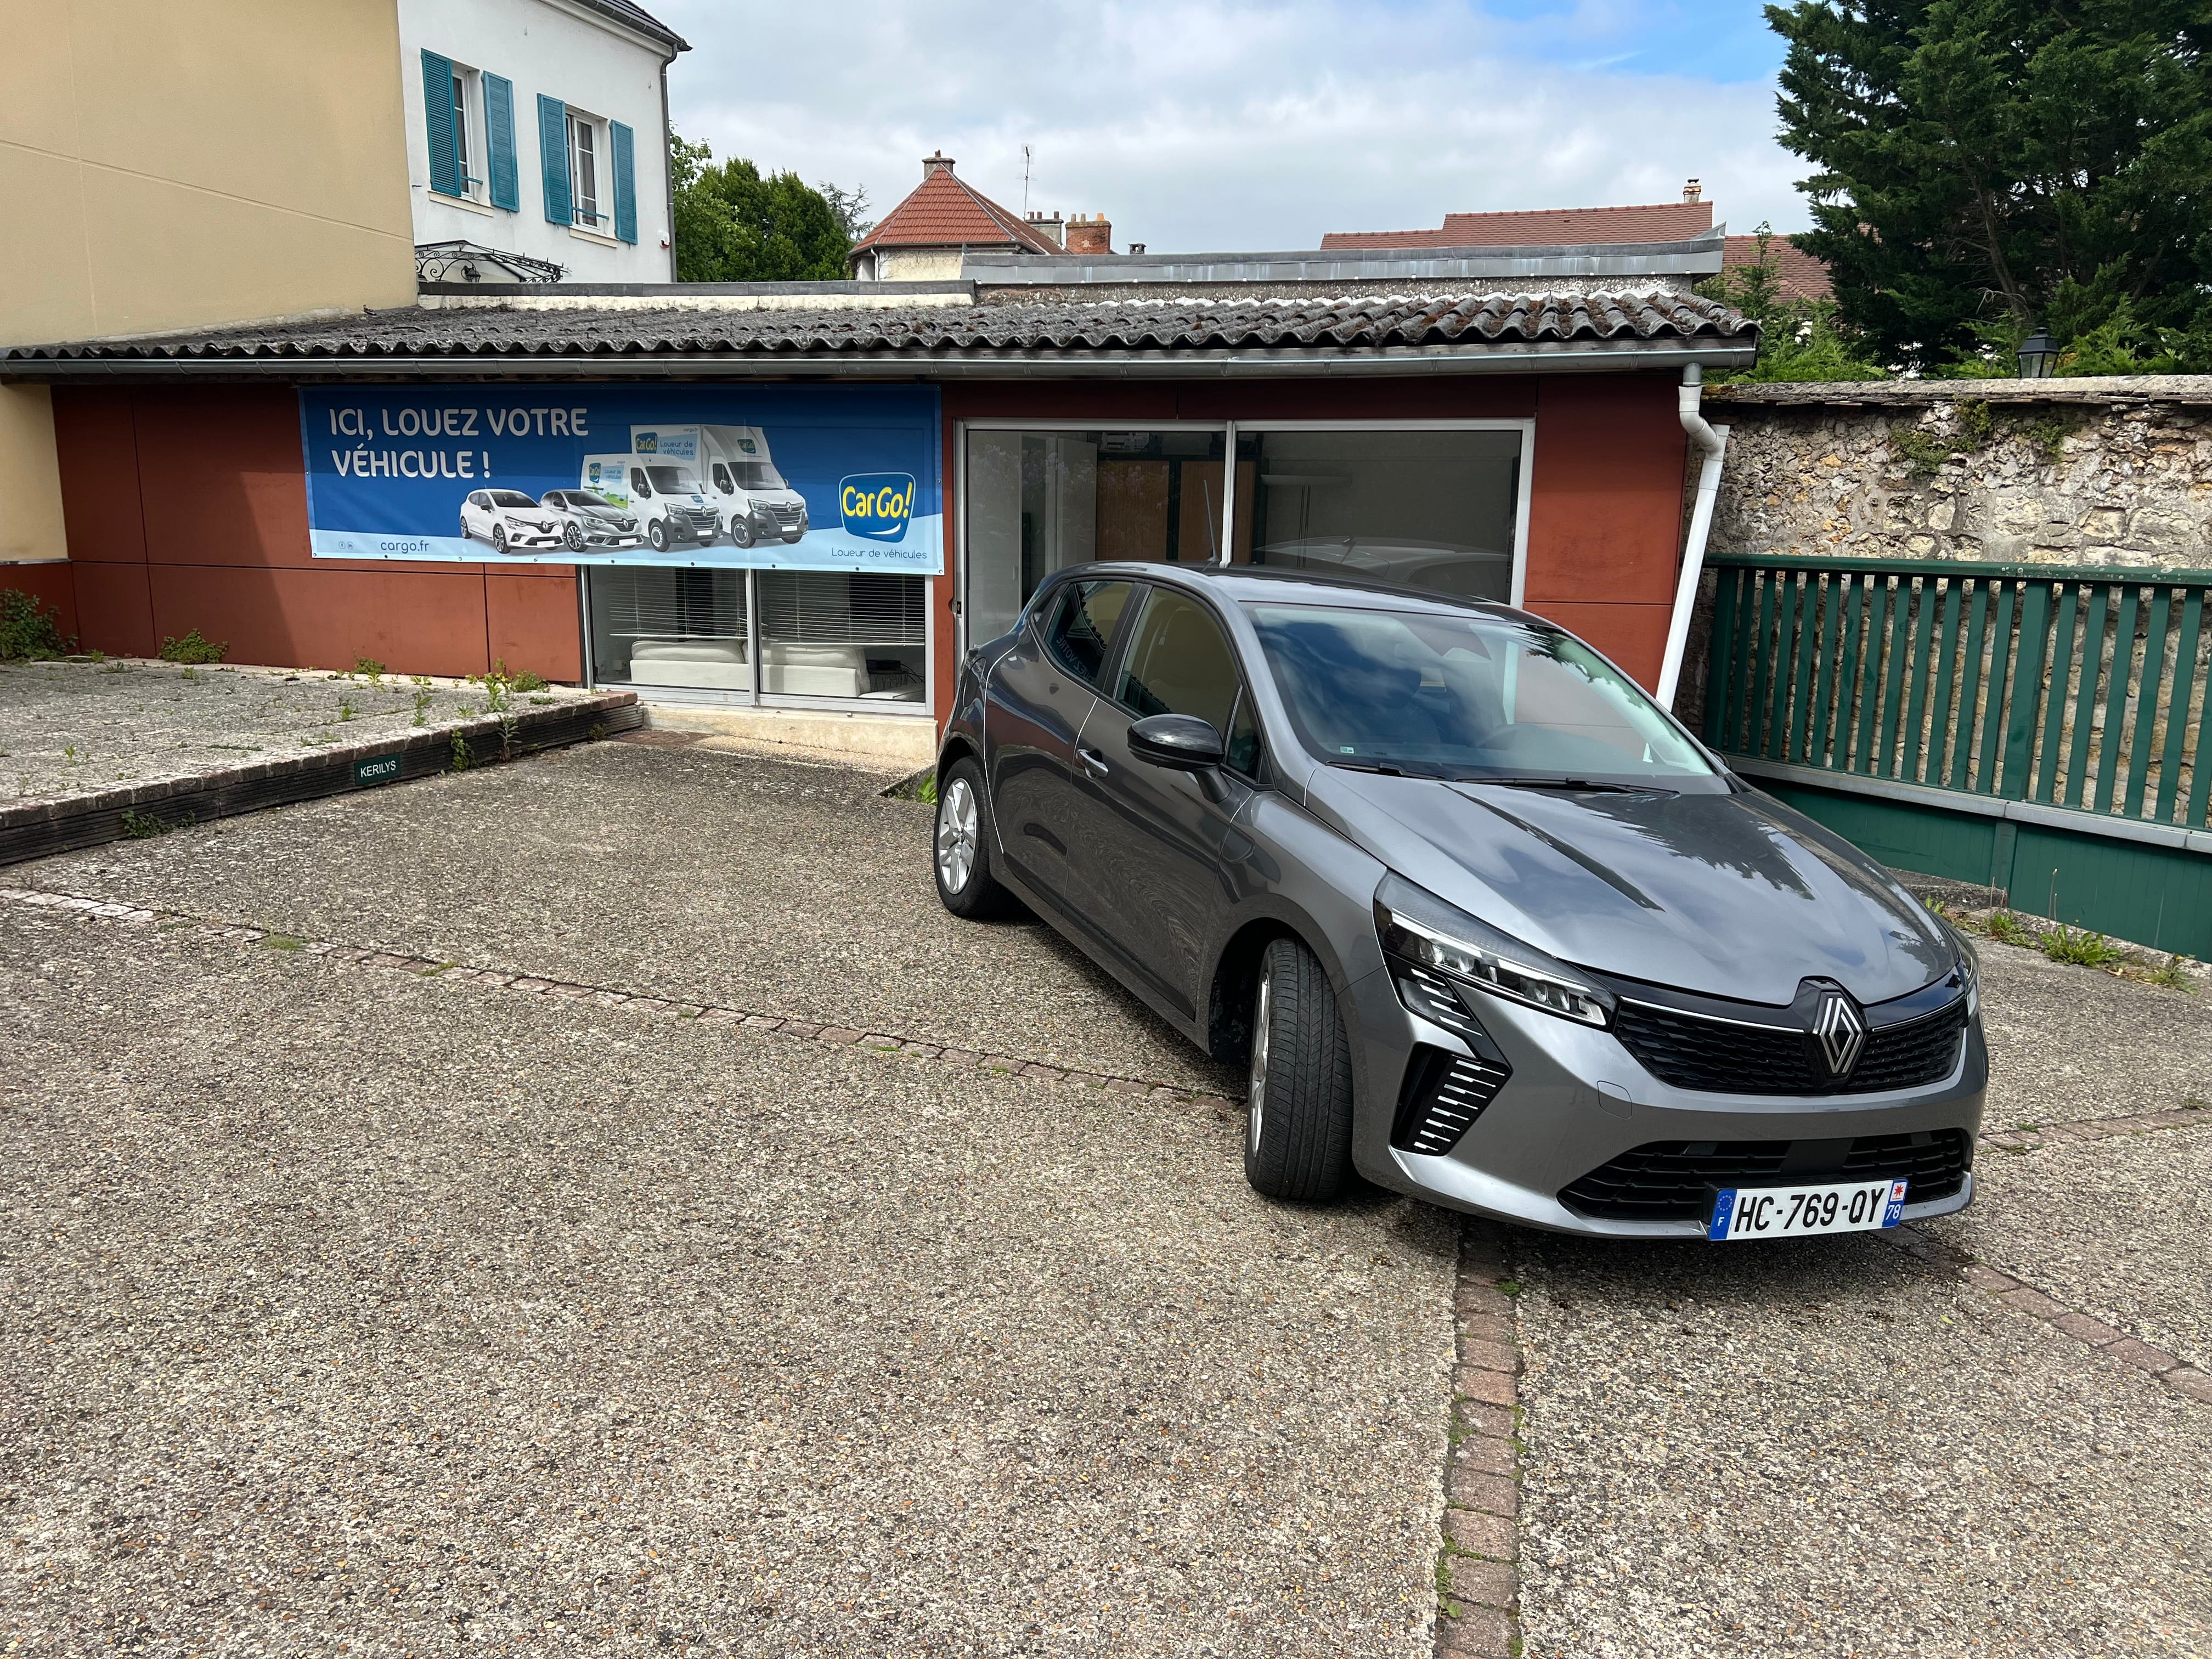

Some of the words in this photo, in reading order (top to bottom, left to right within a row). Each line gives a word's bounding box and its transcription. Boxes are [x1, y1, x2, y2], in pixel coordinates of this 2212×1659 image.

[330, 409, 374, 441] ICI,
[382, 408, 479, 437] LOUEZ
[486, 408, 589, 437] VOTRE
[331, 443, 475, 478] VÉHICULE
[483, 451, 491, 478] !
[663, 448, 694, 456] véhicules
[380, 540, 430, 554] cargo.fr
[832, 548, 865, 557] Loueur
[868, 549, 881, 558] de
[884, 549, 927, 559] véhicules
[360, 760, 396, 778] KERILYS
[1717, 1217, 1724, 1227] F
[1734, 1187, 1885, 1233] HC-769-QY
[1886, 1204, 1901, 1220] 78
